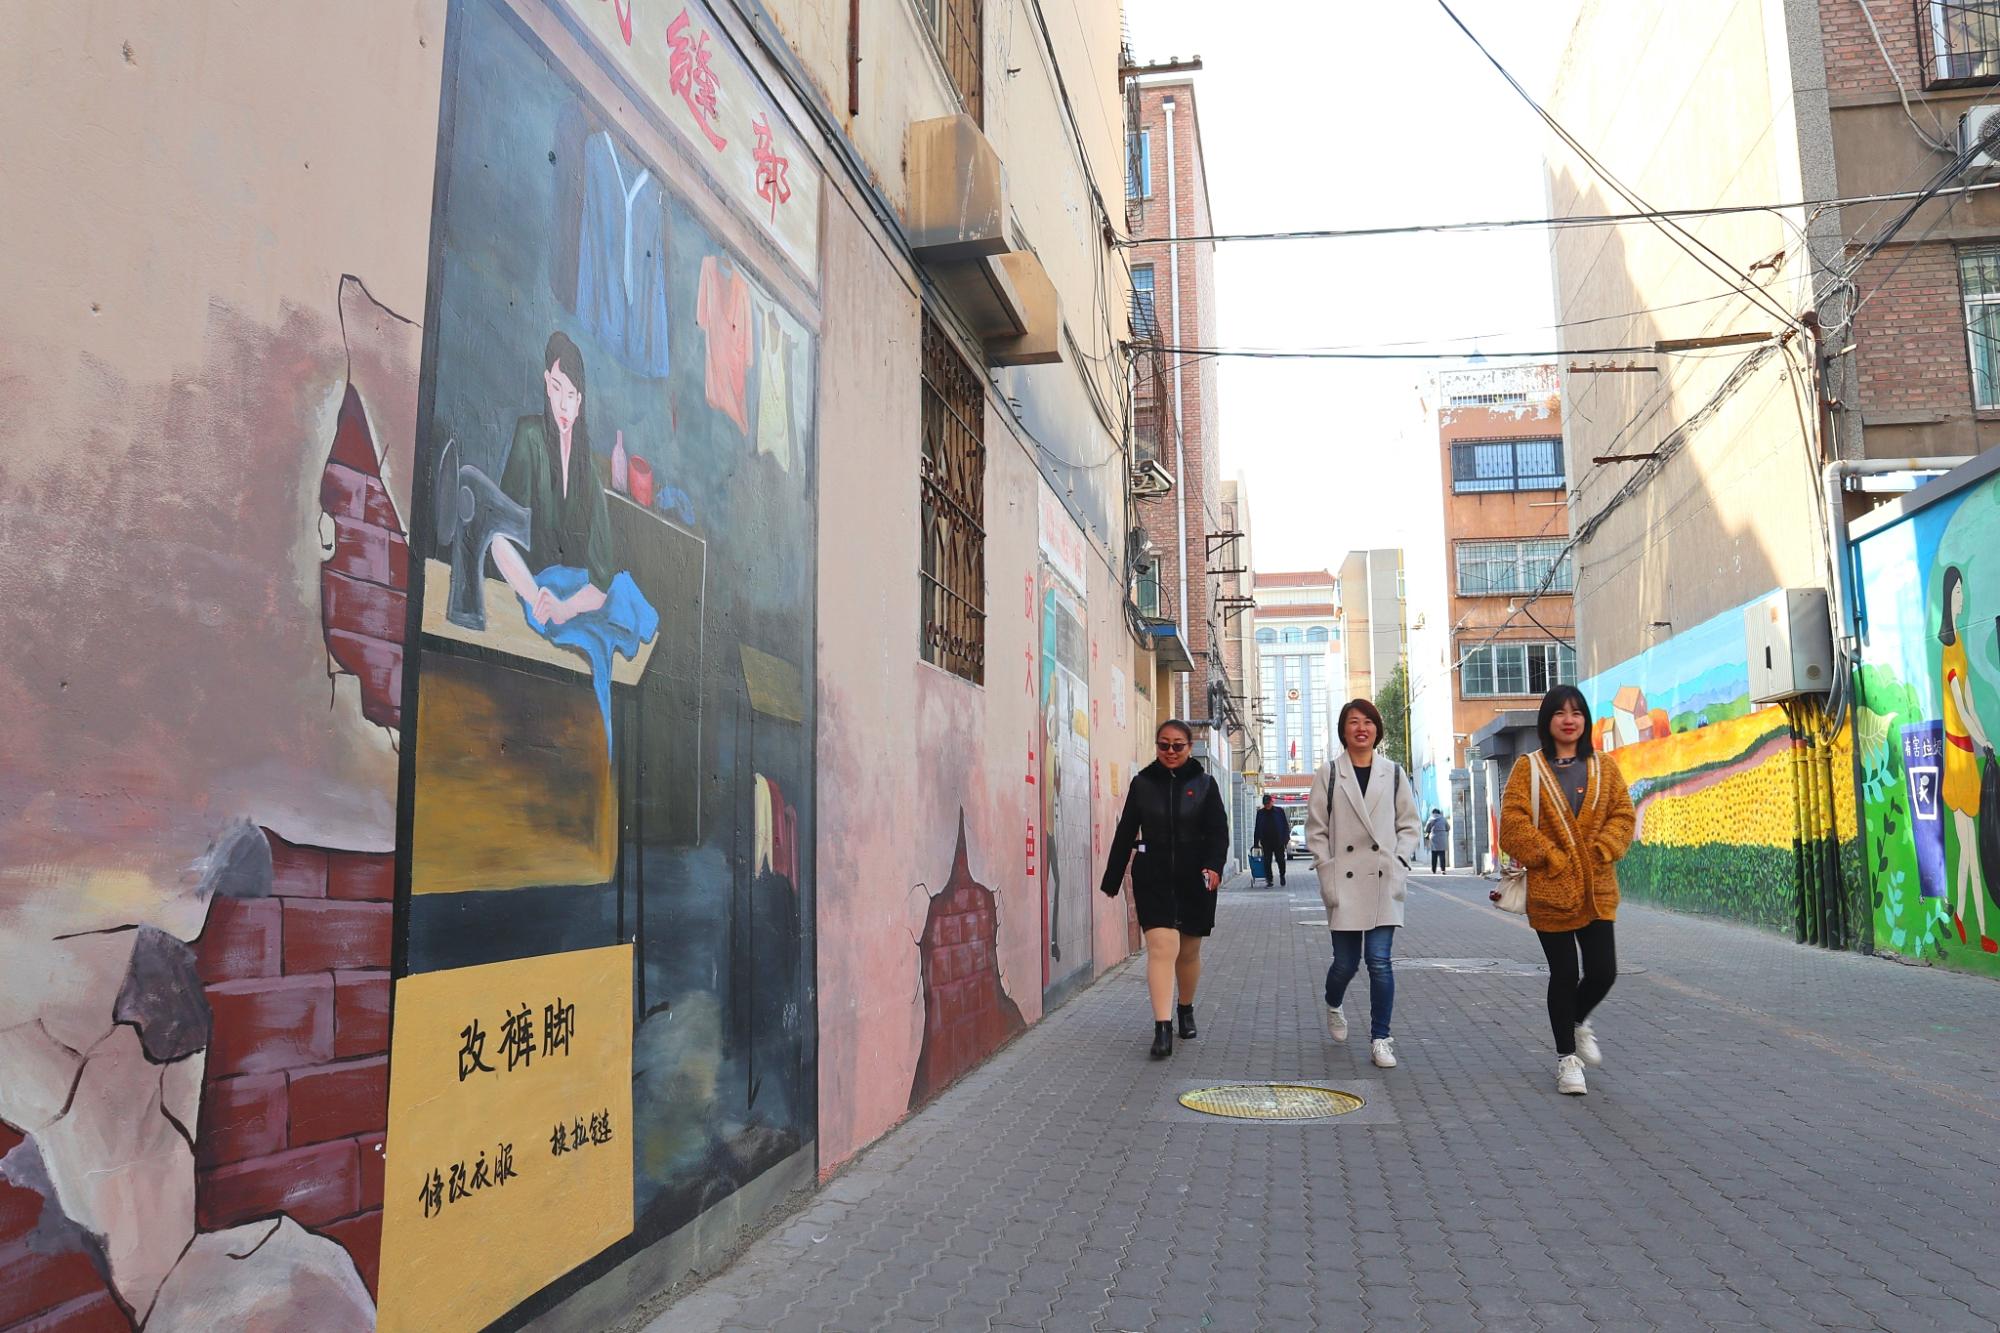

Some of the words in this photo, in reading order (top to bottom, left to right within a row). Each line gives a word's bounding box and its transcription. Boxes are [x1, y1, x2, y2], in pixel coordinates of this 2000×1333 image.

[612, 0, 791, 225] 缝部
[1023, 568, 1036, 876] 放大上色
[458, 997, 575, 1082] 改裤脚
[549, 1107, 614, 1156] 换拉链
[418, 1142, 519, 1218] 修改衣服
